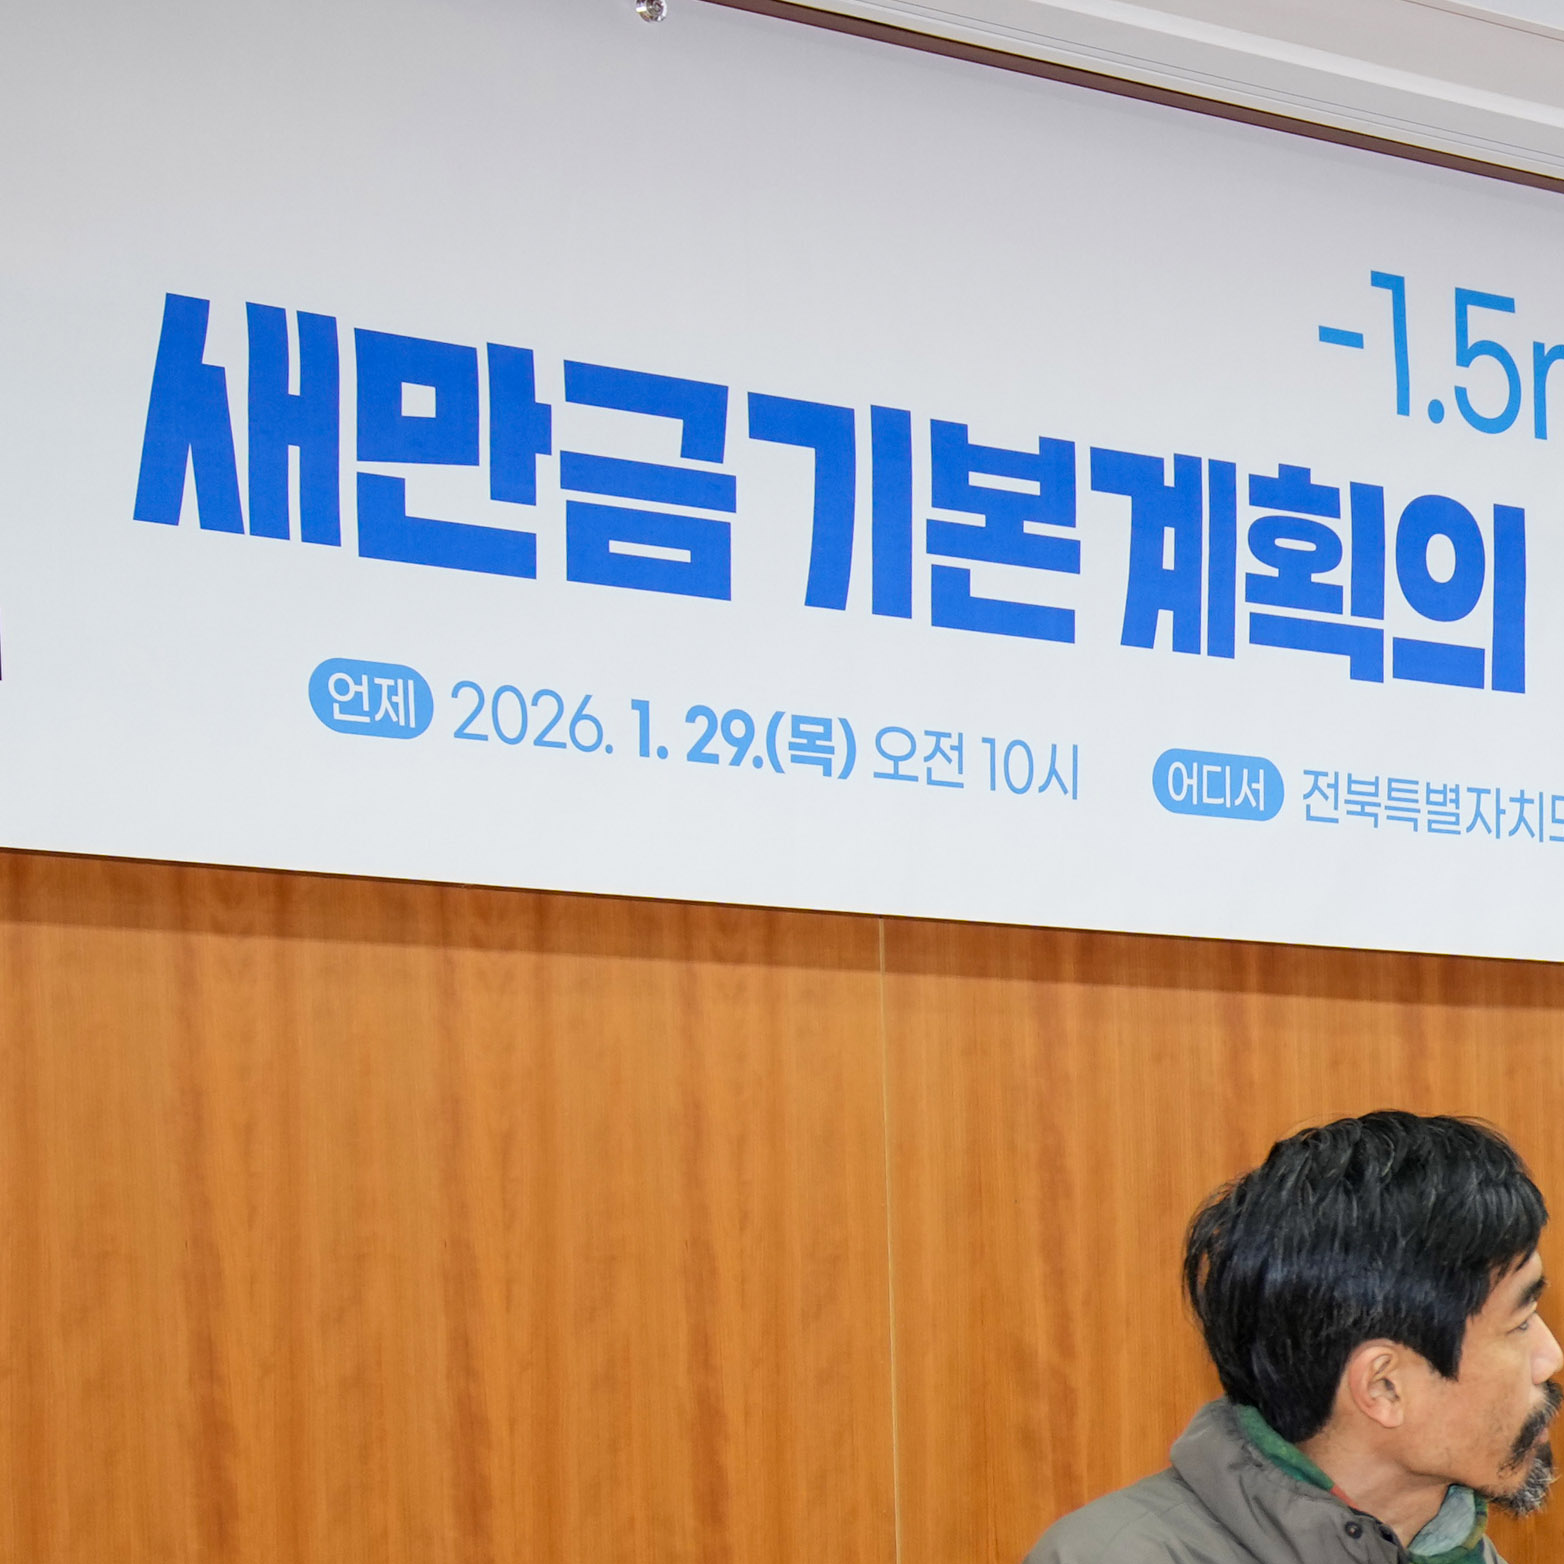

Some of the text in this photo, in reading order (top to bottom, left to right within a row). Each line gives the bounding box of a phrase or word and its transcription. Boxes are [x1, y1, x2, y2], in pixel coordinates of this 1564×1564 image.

[132, 292, 1527, 695] 새만금기본계획의
[327, 671, 1080, 802] 언제 2026. 1. 29.(목) 오전 10시
[1166, 760, 1266, 812] 어디서
